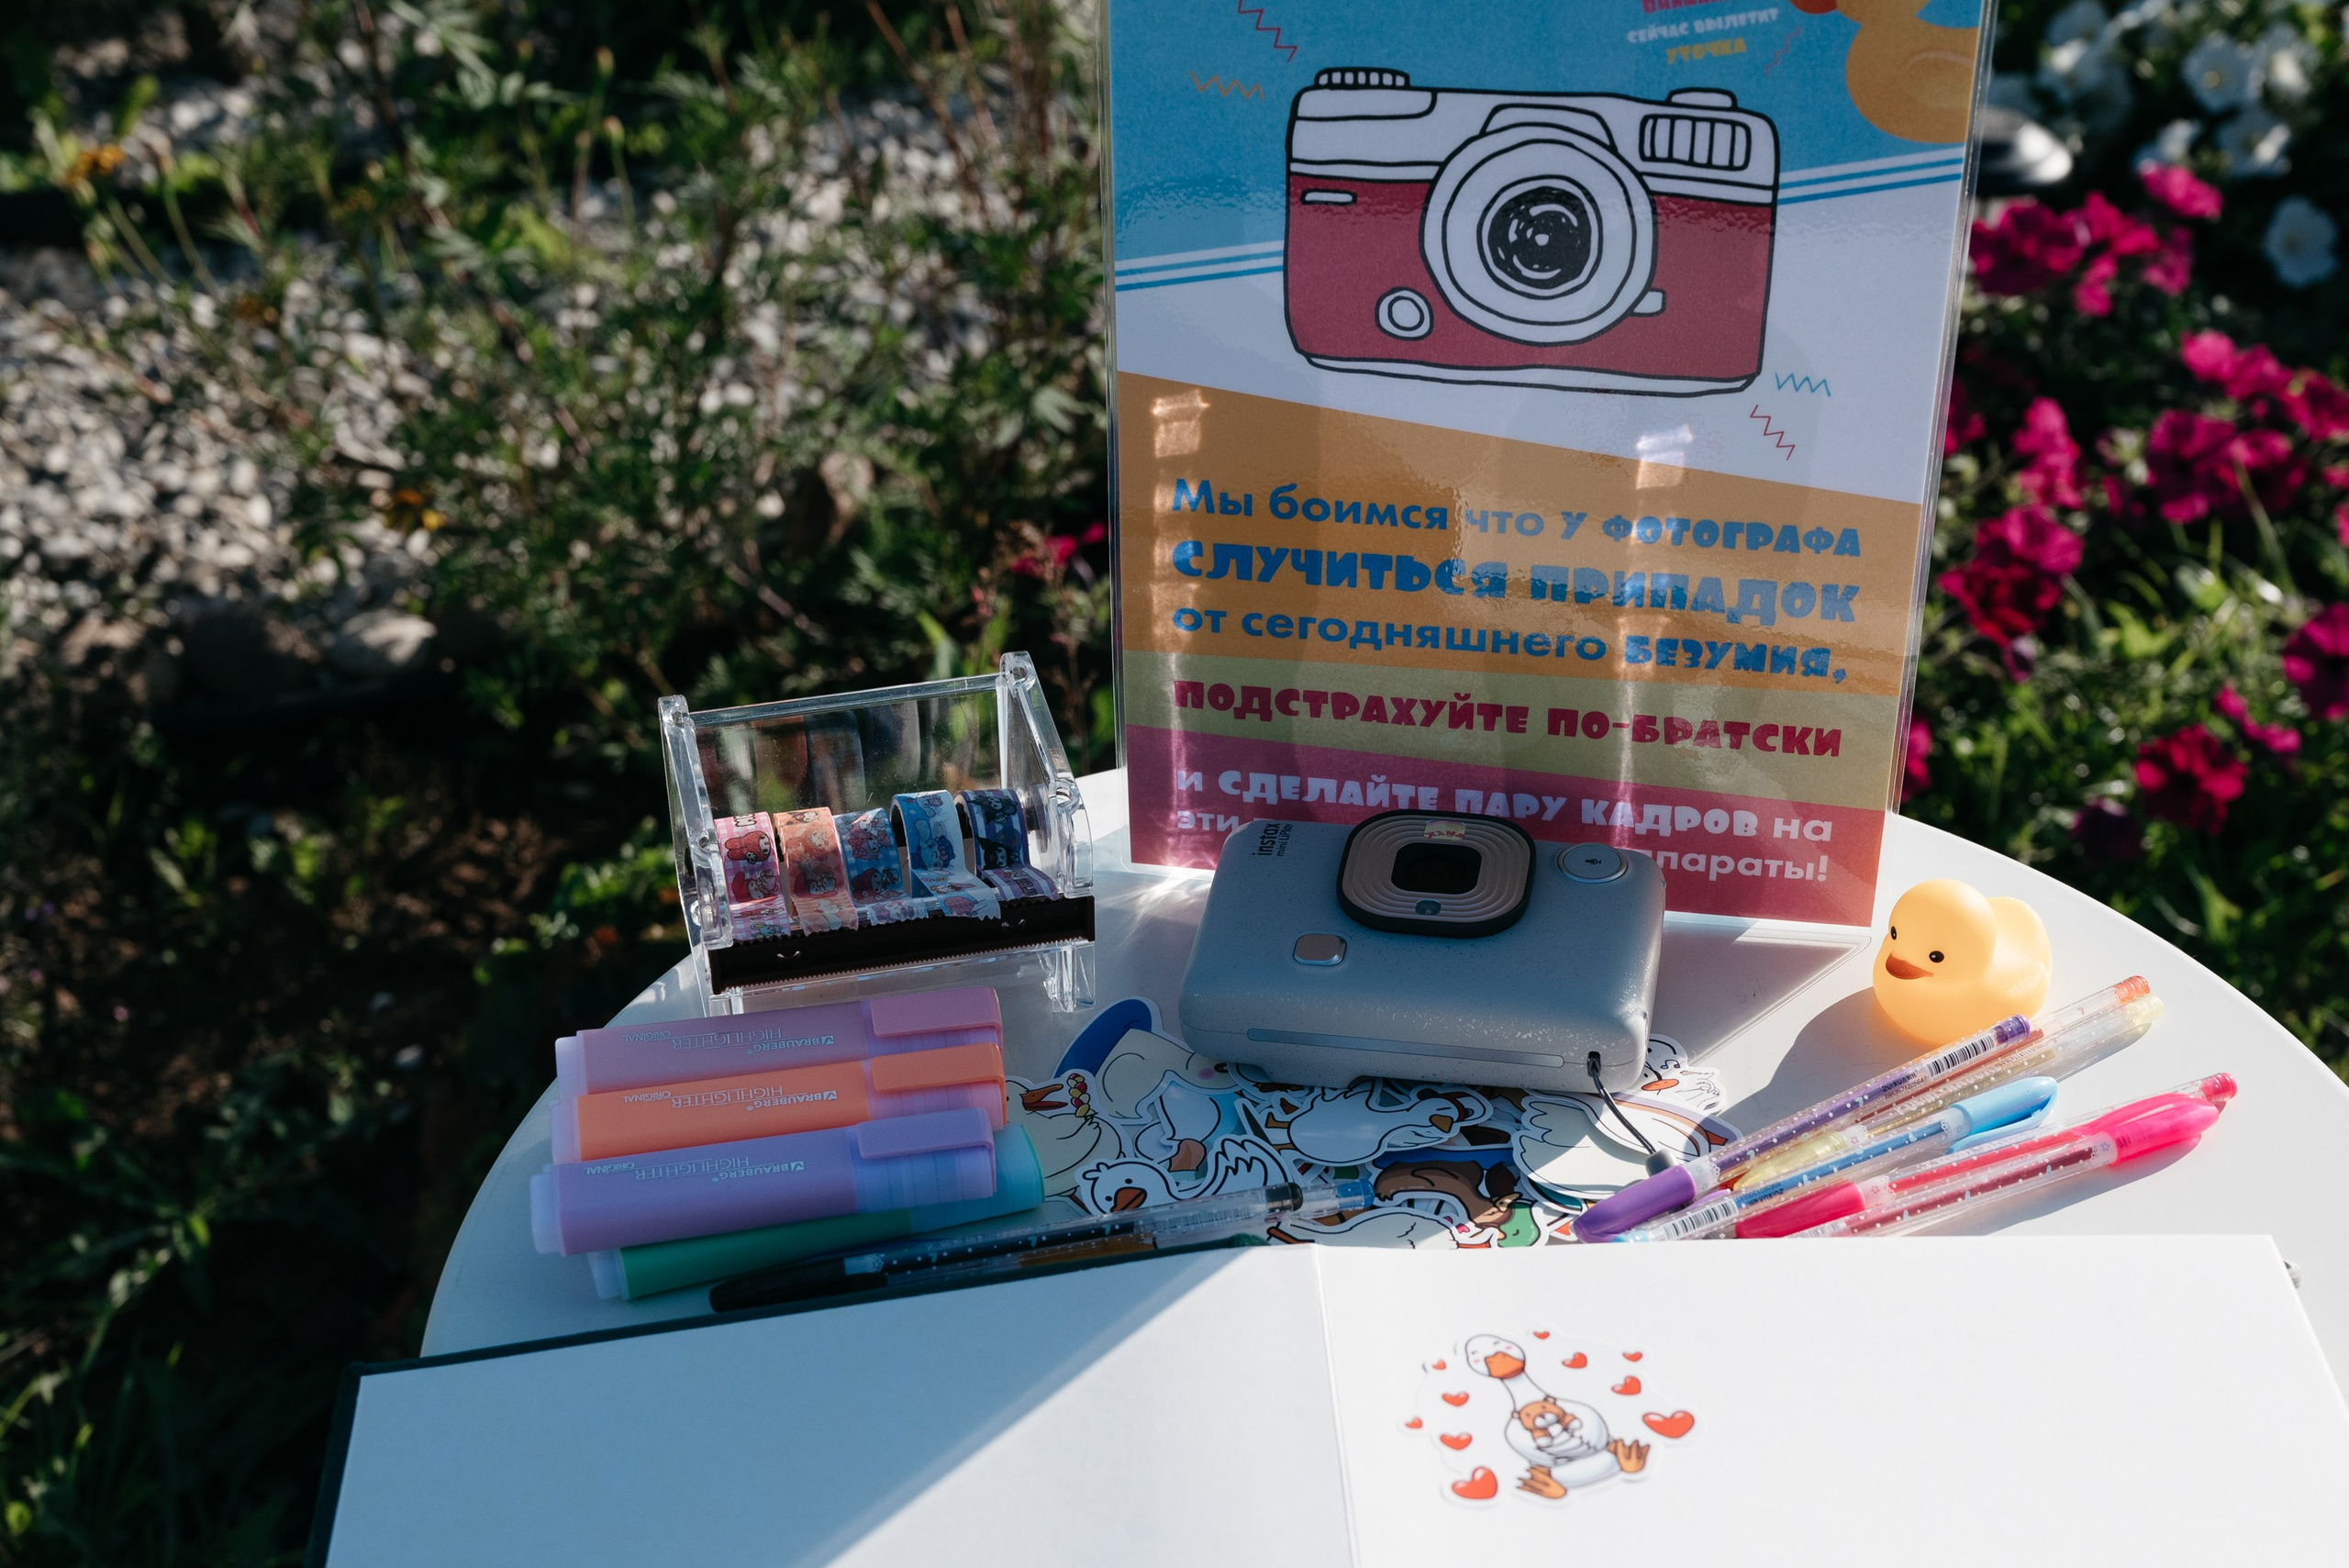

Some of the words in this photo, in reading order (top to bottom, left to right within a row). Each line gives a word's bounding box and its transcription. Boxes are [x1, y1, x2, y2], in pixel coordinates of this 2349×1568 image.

[1627, 21, 1690, 44] СЕЙЧАС
[1665, 37, 1747, 64] УТОЧКА
[1172, 478, 1253, 517] Мы
[1269, 483, 1449, 530] боимся
[1464, 508, 1545, 538] что
[1601, 514, 1861, 557] ФОТОГРАФА
[1172, 539, 1508, 599] СЛУЧИТЬСЯ
[1531, 564, 1861, 627] ПРИПАДОК
[1172, 607, 1227, 633] от
[1241, 612, 1607, 661] сегодняшнего
[1624, 634, 1847, 684] БЕЗУМИЯ,
[1174, 680, 1530, 734] ПОДСТРАХУЙТЕ
[1547, 707, 1842, 758] ПО-БРАТСКИ
[1218, 770, 1440, 812] СДЕЛАЙТЕ
[1454, 787, 1567, 822] ПАРУ
[1581, 799, 1759, 838] КАДРОВ
[1773, 817, 1832, 842] на
[1177, 810, 1240, 833] эти
[1631, 850, 1829, 883] параты!
[1252, 823, 1281, 856] instax
[622, 1029, 672, 1043] ORIGINAL
[672, 1027, 782, 1051] HIGHLIGHTER
[621, 1090, 672, 1103] ORIGINAL
[671, 1084, 784, 1108] HIGHLIGHTER
[584, 1161, 635, 1175] ORIGINAL
[634, 1155, 751, 1180] HIGHLIGHTER
